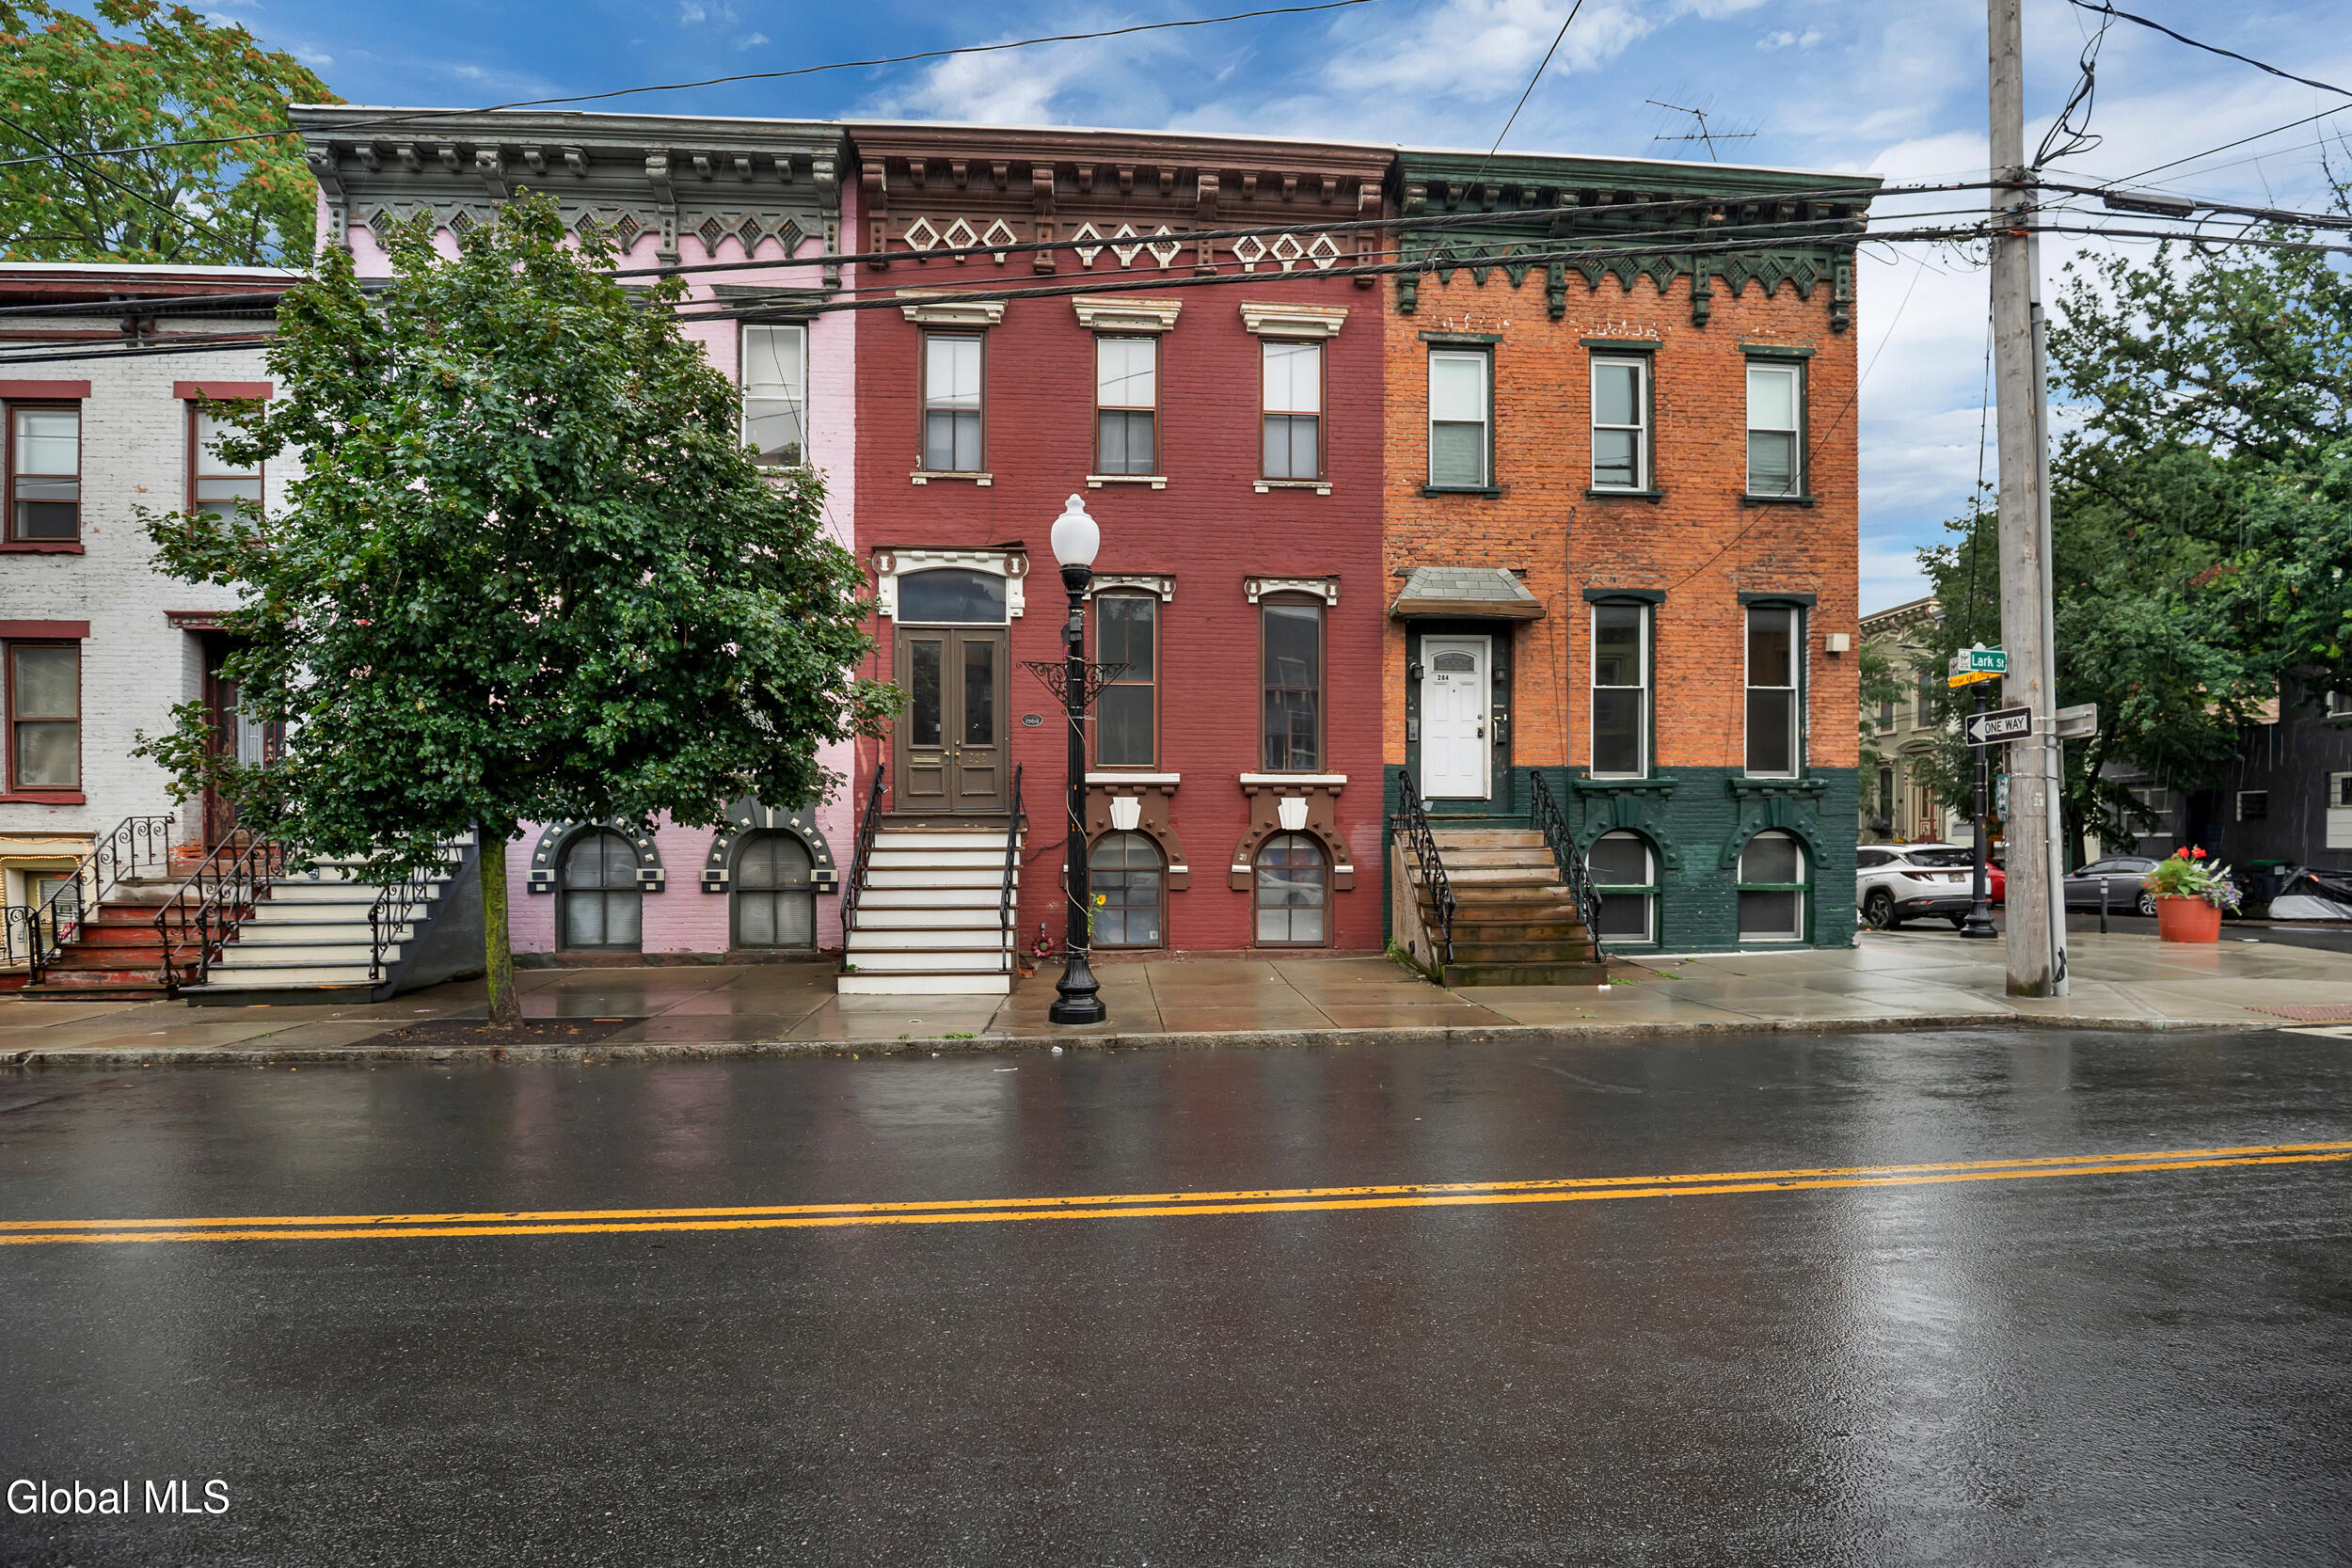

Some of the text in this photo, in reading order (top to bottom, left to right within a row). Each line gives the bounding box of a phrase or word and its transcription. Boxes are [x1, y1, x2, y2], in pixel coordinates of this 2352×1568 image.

[1972, 655, 1994, 668] Lark
[1996, 657, 2005, 669] St
[1984, 717, 2025, 735] ONE WAY
